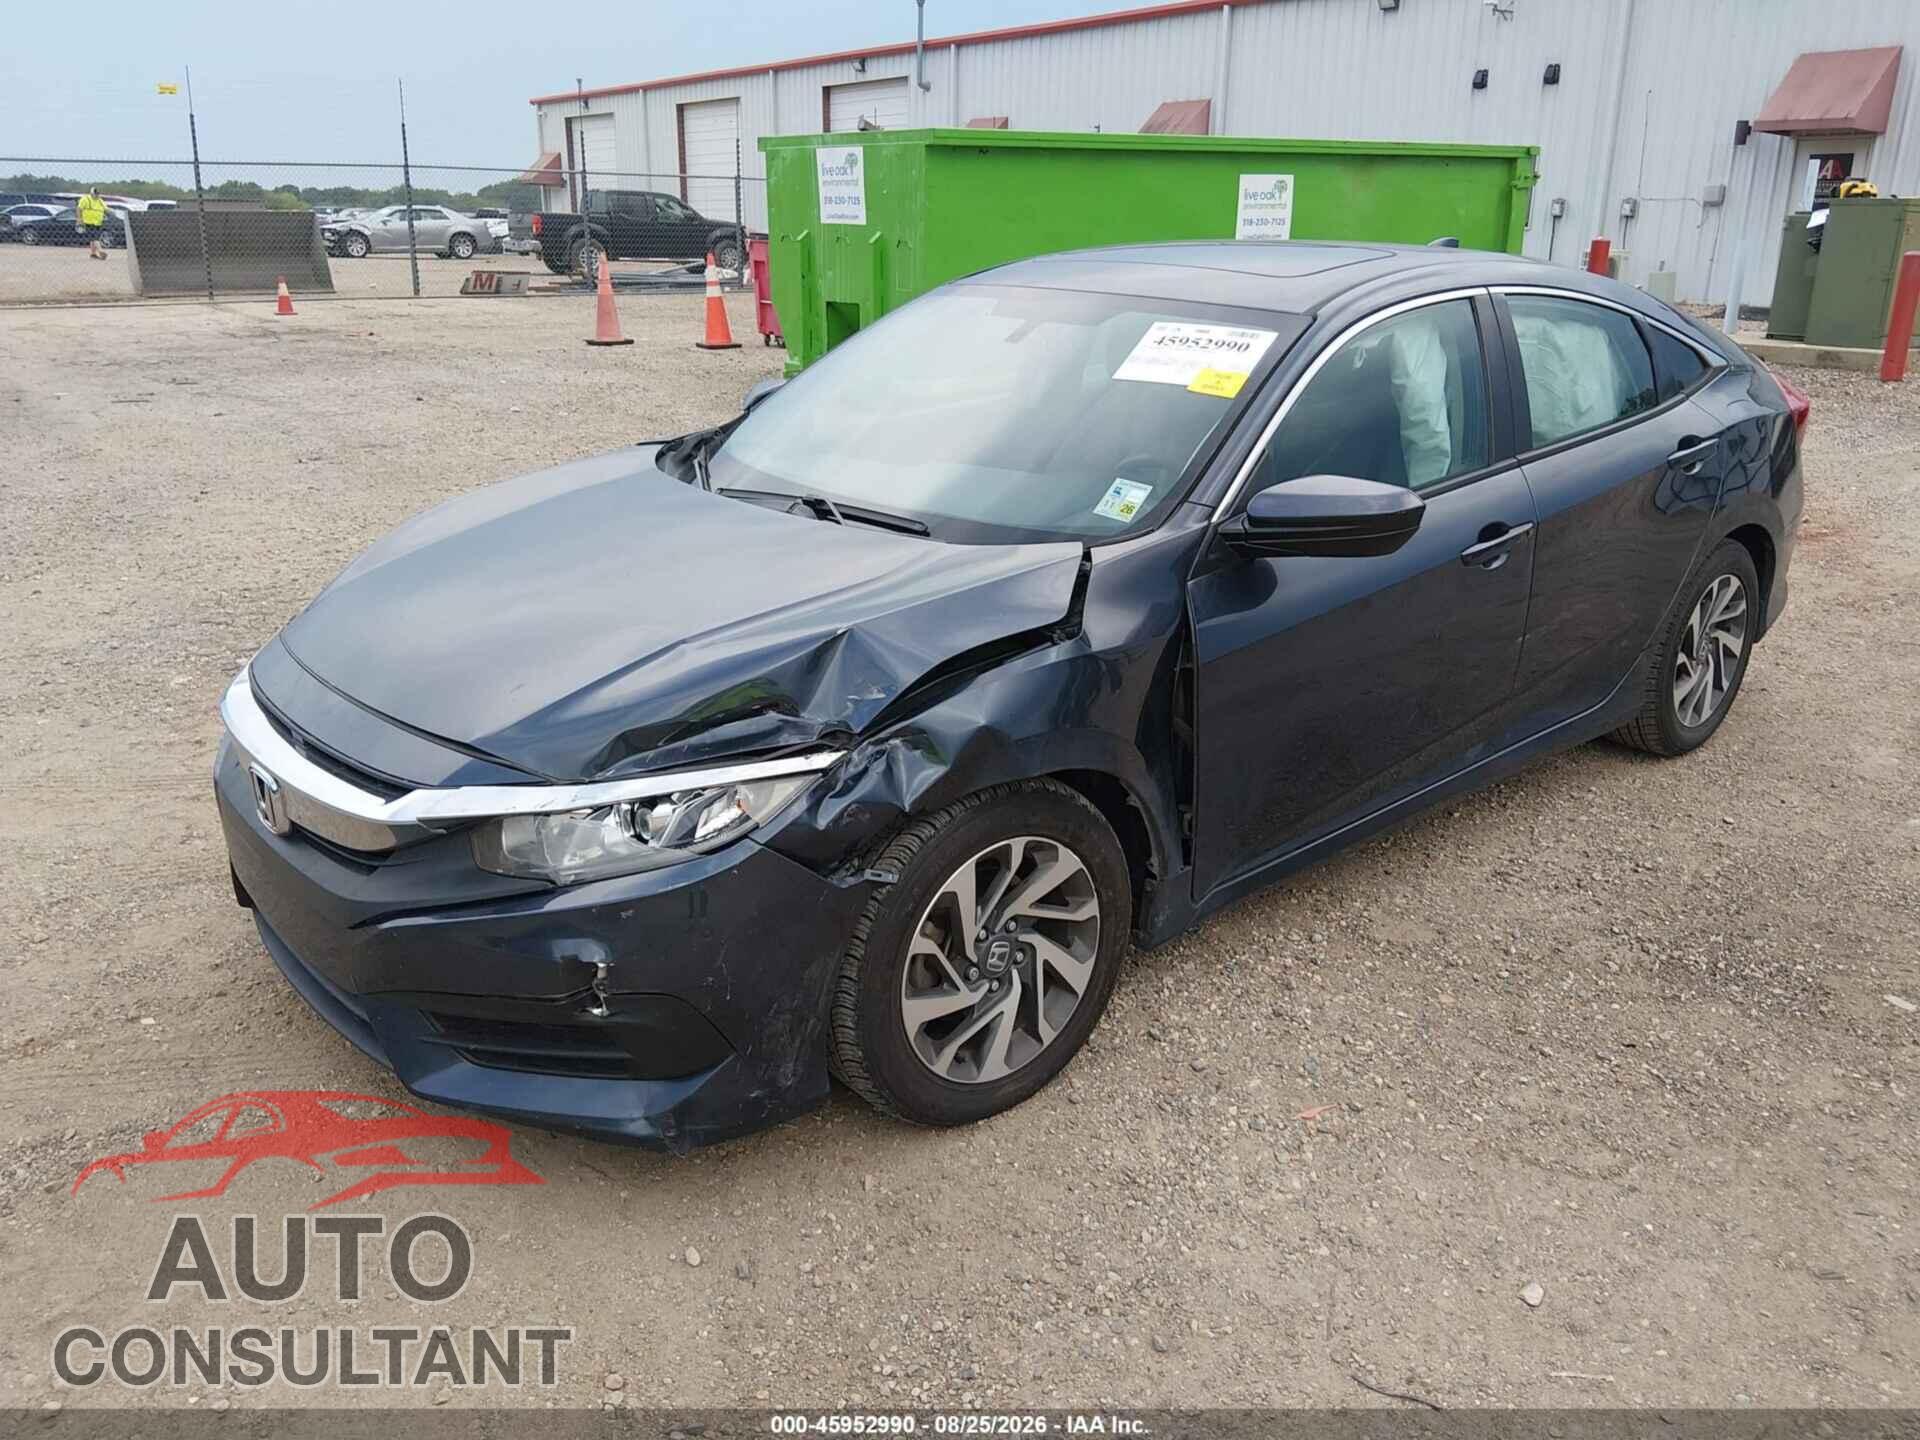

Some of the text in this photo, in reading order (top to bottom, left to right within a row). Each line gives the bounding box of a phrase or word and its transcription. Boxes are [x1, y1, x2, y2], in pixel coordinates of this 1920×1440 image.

[1243, 188, 1277, 201] live oak
[1153, 335, 1252, 353] 45952990
